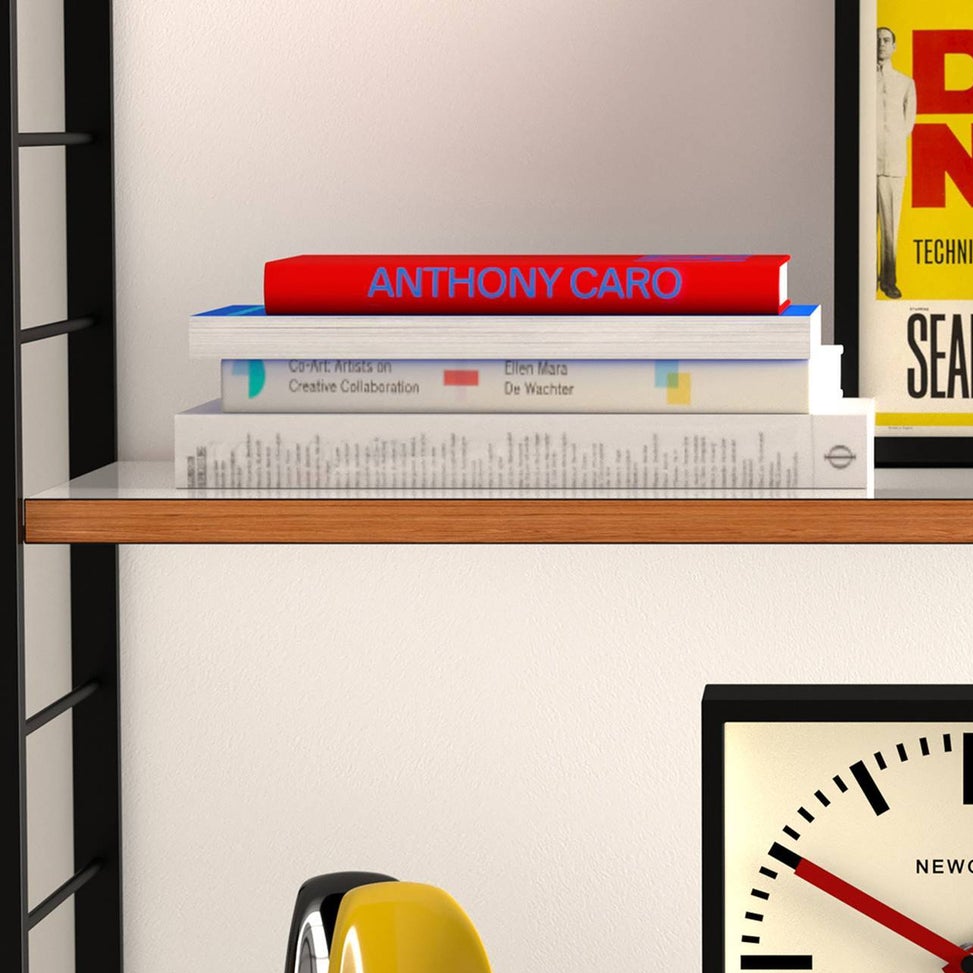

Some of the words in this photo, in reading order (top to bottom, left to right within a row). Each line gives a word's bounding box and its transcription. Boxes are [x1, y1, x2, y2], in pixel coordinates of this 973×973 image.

[367, 266, 564, 301] ANTHONY
[569, 267, 684, 301] CARO
[334, 359, 374, 373] Artists
[376, 361, 392, 373] on
[504, 360, 534, 376] Ellen
[537, 360, 568, 376] Mara
[288, 378, 337, 393] Creative
[340, 378, 420, 393] Collaboration
[504, 381, 521, 395] De
[524, 381, 575, 395] Wachter
